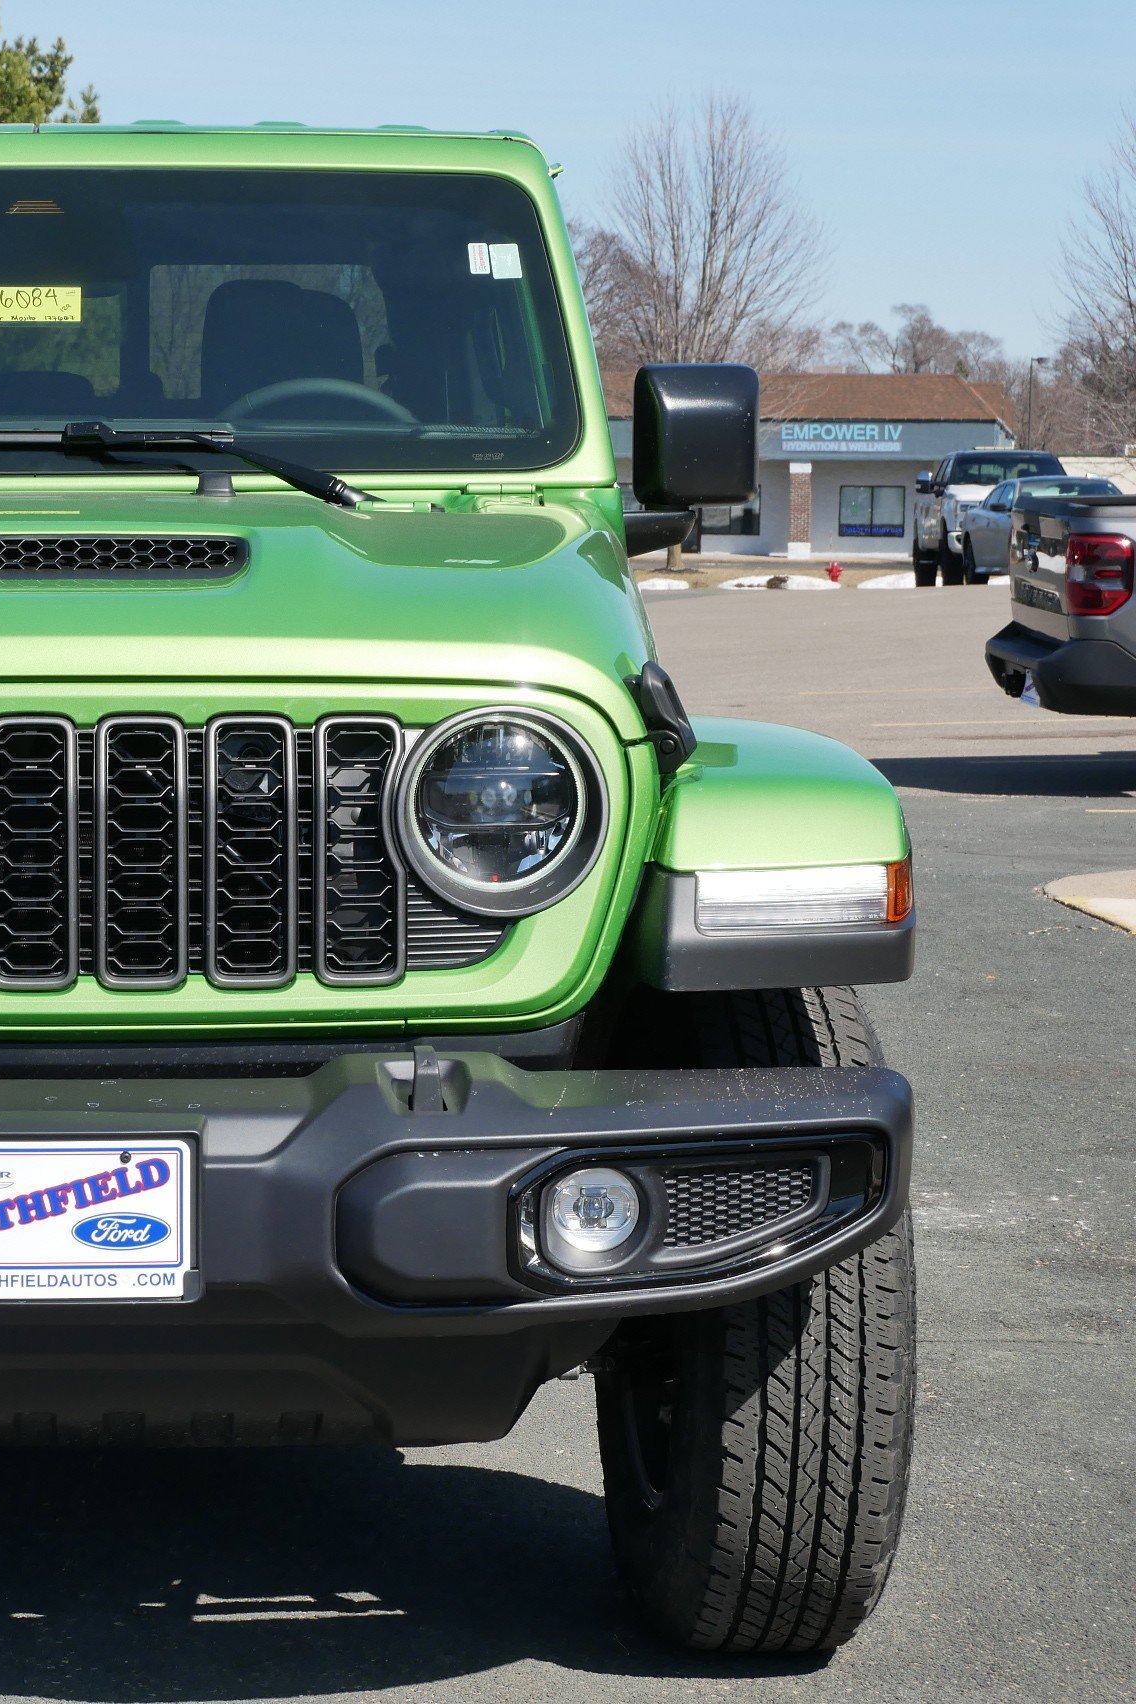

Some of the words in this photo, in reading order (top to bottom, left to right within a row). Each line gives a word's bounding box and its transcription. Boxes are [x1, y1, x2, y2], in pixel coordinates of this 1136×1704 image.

[781, 424, 879, 440] EMPOWER
[884, 424, 902, 440] IV
[782, 441, 838, 451] HYDRATION
[848, 441, 901, 451] WELLNESS
[90, 1217, 151, 1244] Ford
[132, 1272, 176, 1287] .COM
